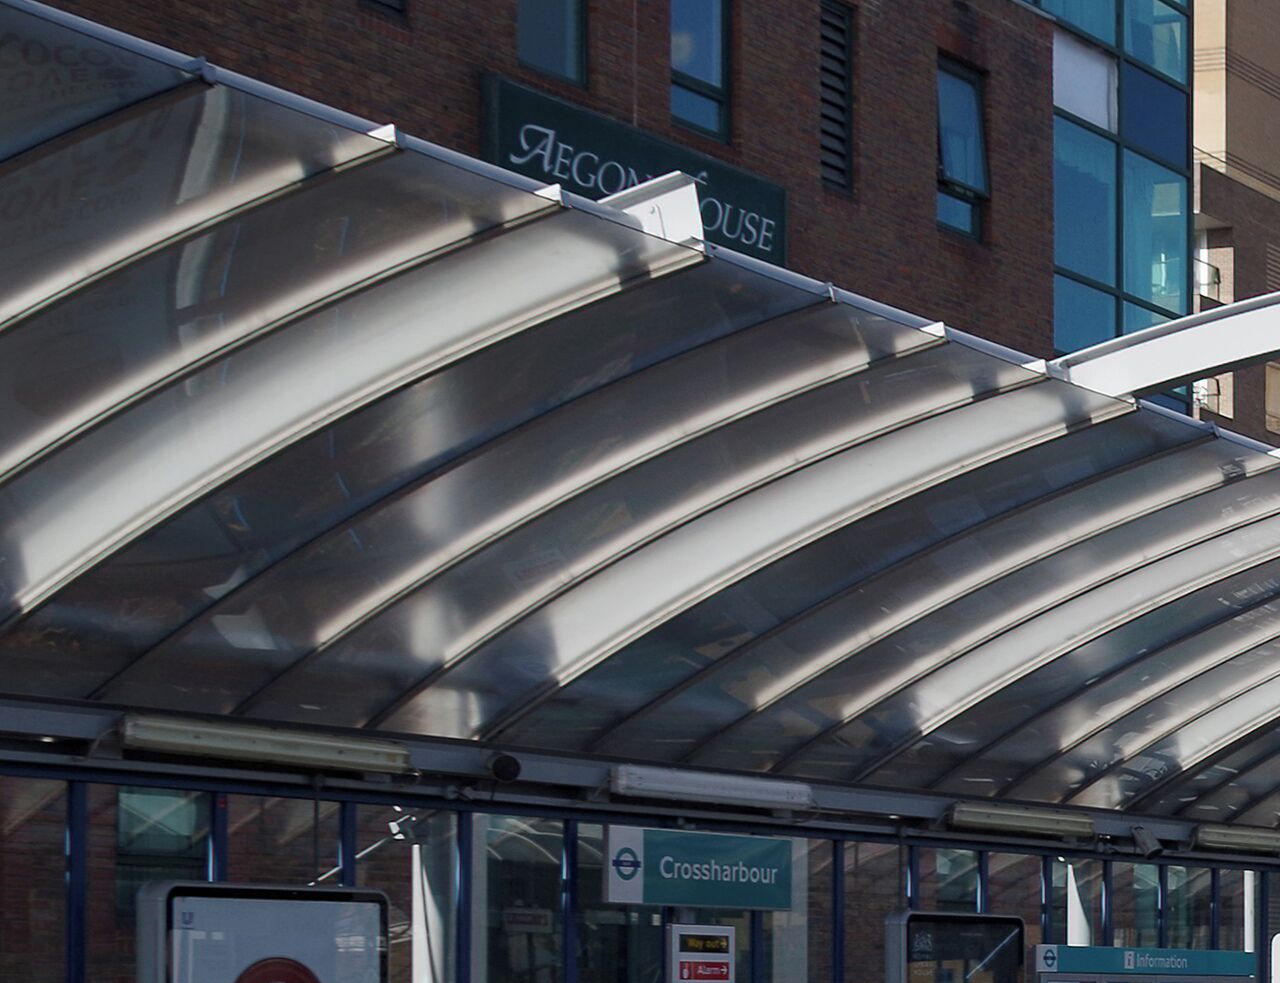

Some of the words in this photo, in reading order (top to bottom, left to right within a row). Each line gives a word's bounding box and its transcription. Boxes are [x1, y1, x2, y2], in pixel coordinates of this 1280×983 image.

[698, 176, 776, 251] OUSE
[660, 855, 778, 884] Crossharbour
[696, 965, 720, 975] Alarm
[1136, 953, 1188, 969] Information
